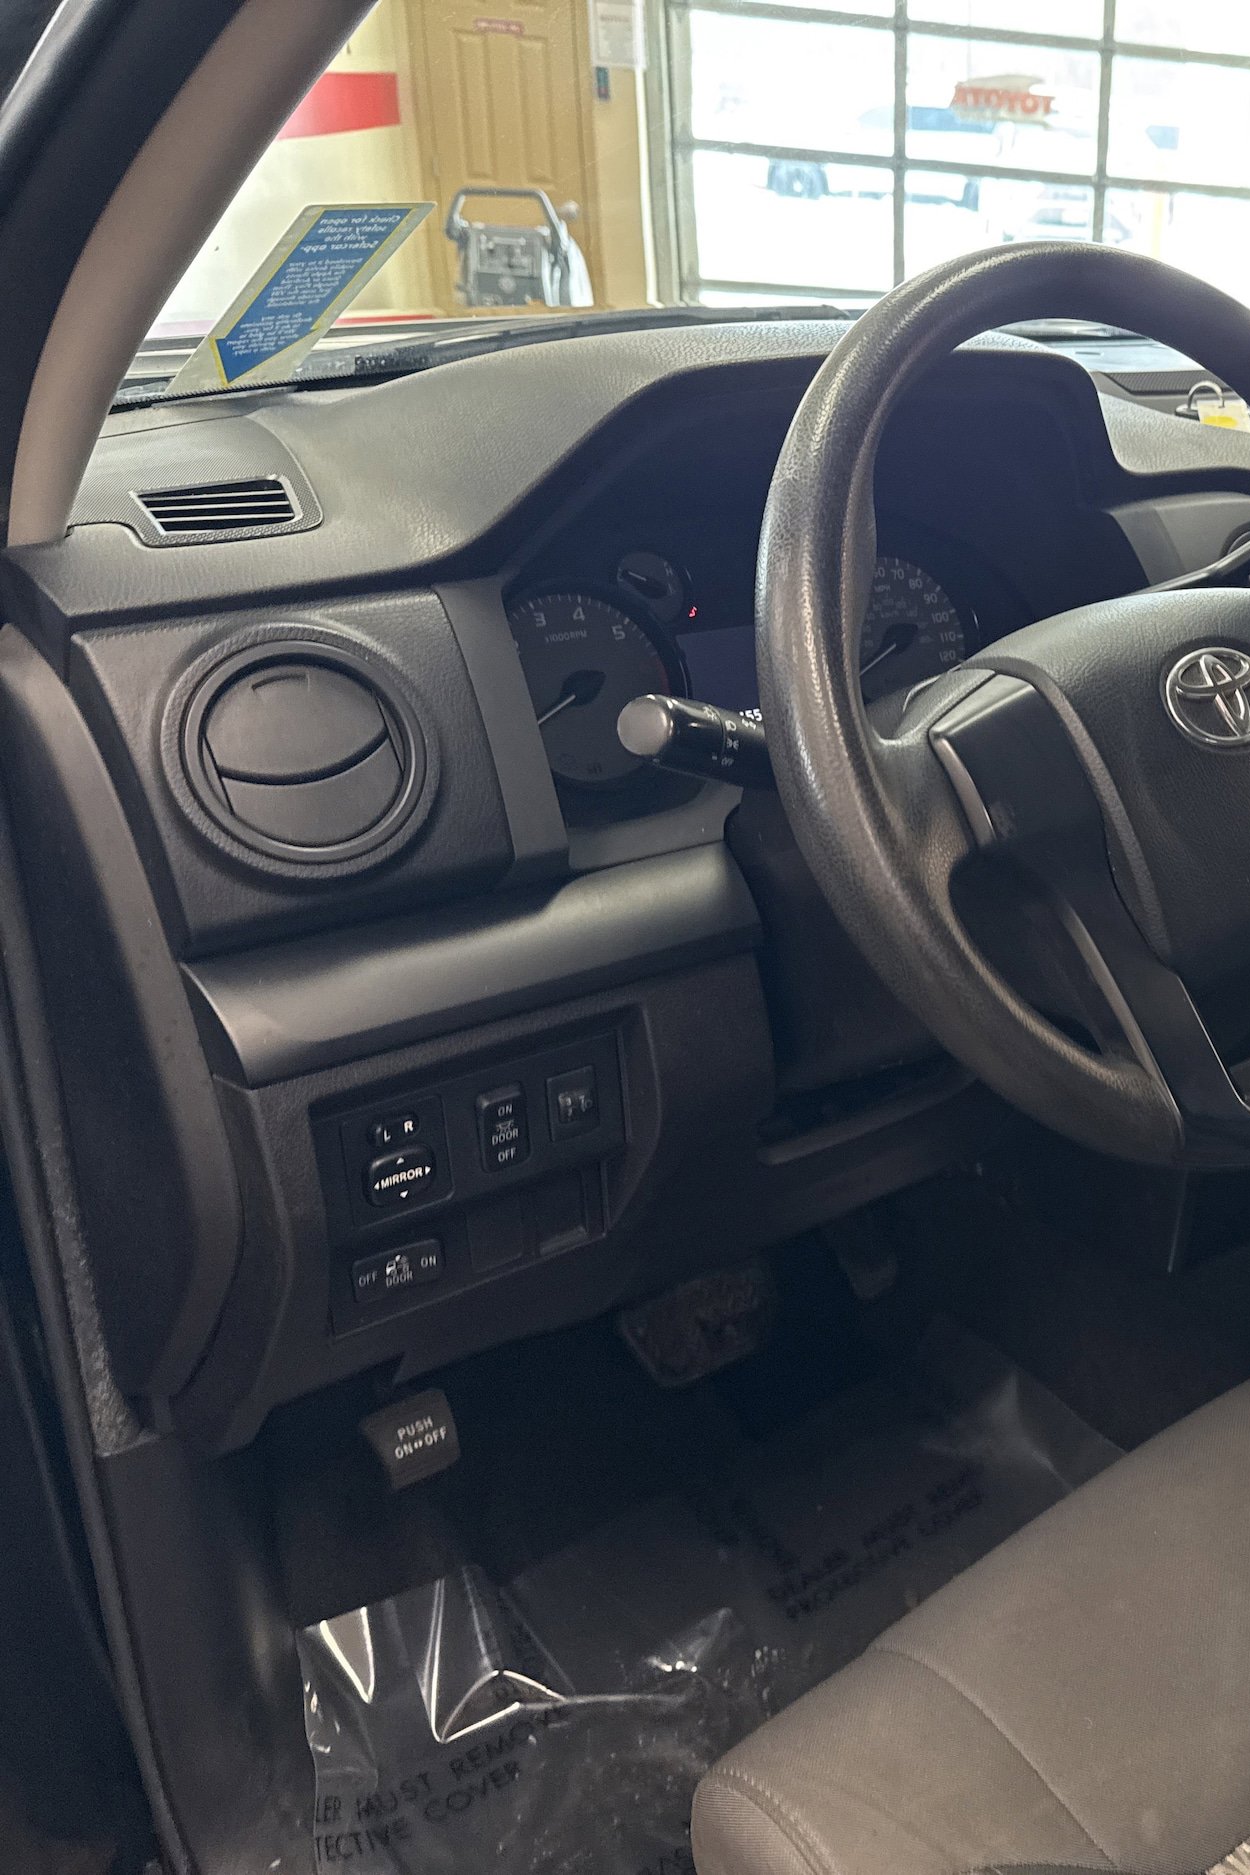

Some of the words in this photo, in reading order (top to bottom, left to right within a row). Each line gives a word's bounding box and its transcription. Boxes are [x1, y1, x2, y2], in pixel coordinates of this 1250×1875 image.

[890, 568, 905, 580] 70
[924, 593, 938, 605] 90
[533, 612, 547, 628] 3
[573, 606, 586, 622] 4
[932, 612, 949, 624] 100
[612, 625, 626, 641] 5
[940, 631, 956, 643] 110
[939, 650, 956, 662] 120
[497, 1103, 513, 1117] ON
[403, 1120, 414, 1133] R
[383, 1129, 392, 1143] L
[491, 1127, 519, 1147] DOOR
[497, 1147, 516, 1163] OFF
[380, 1166, 424, 1190] MIRROR
[420, 1254, 437, 1269] ON
[358, 1270, 378, 1288] OFF
[385, 1269, 414, 1289] DOOR
[396, 1415, 434, 1442] PUSH
[394, 1441, 414, 1460] ON
[424, 1425, 447, 1446] OFF
[356, 1771, 432, 1821] MUST
[424, 1760, 523, 1823] COVER
